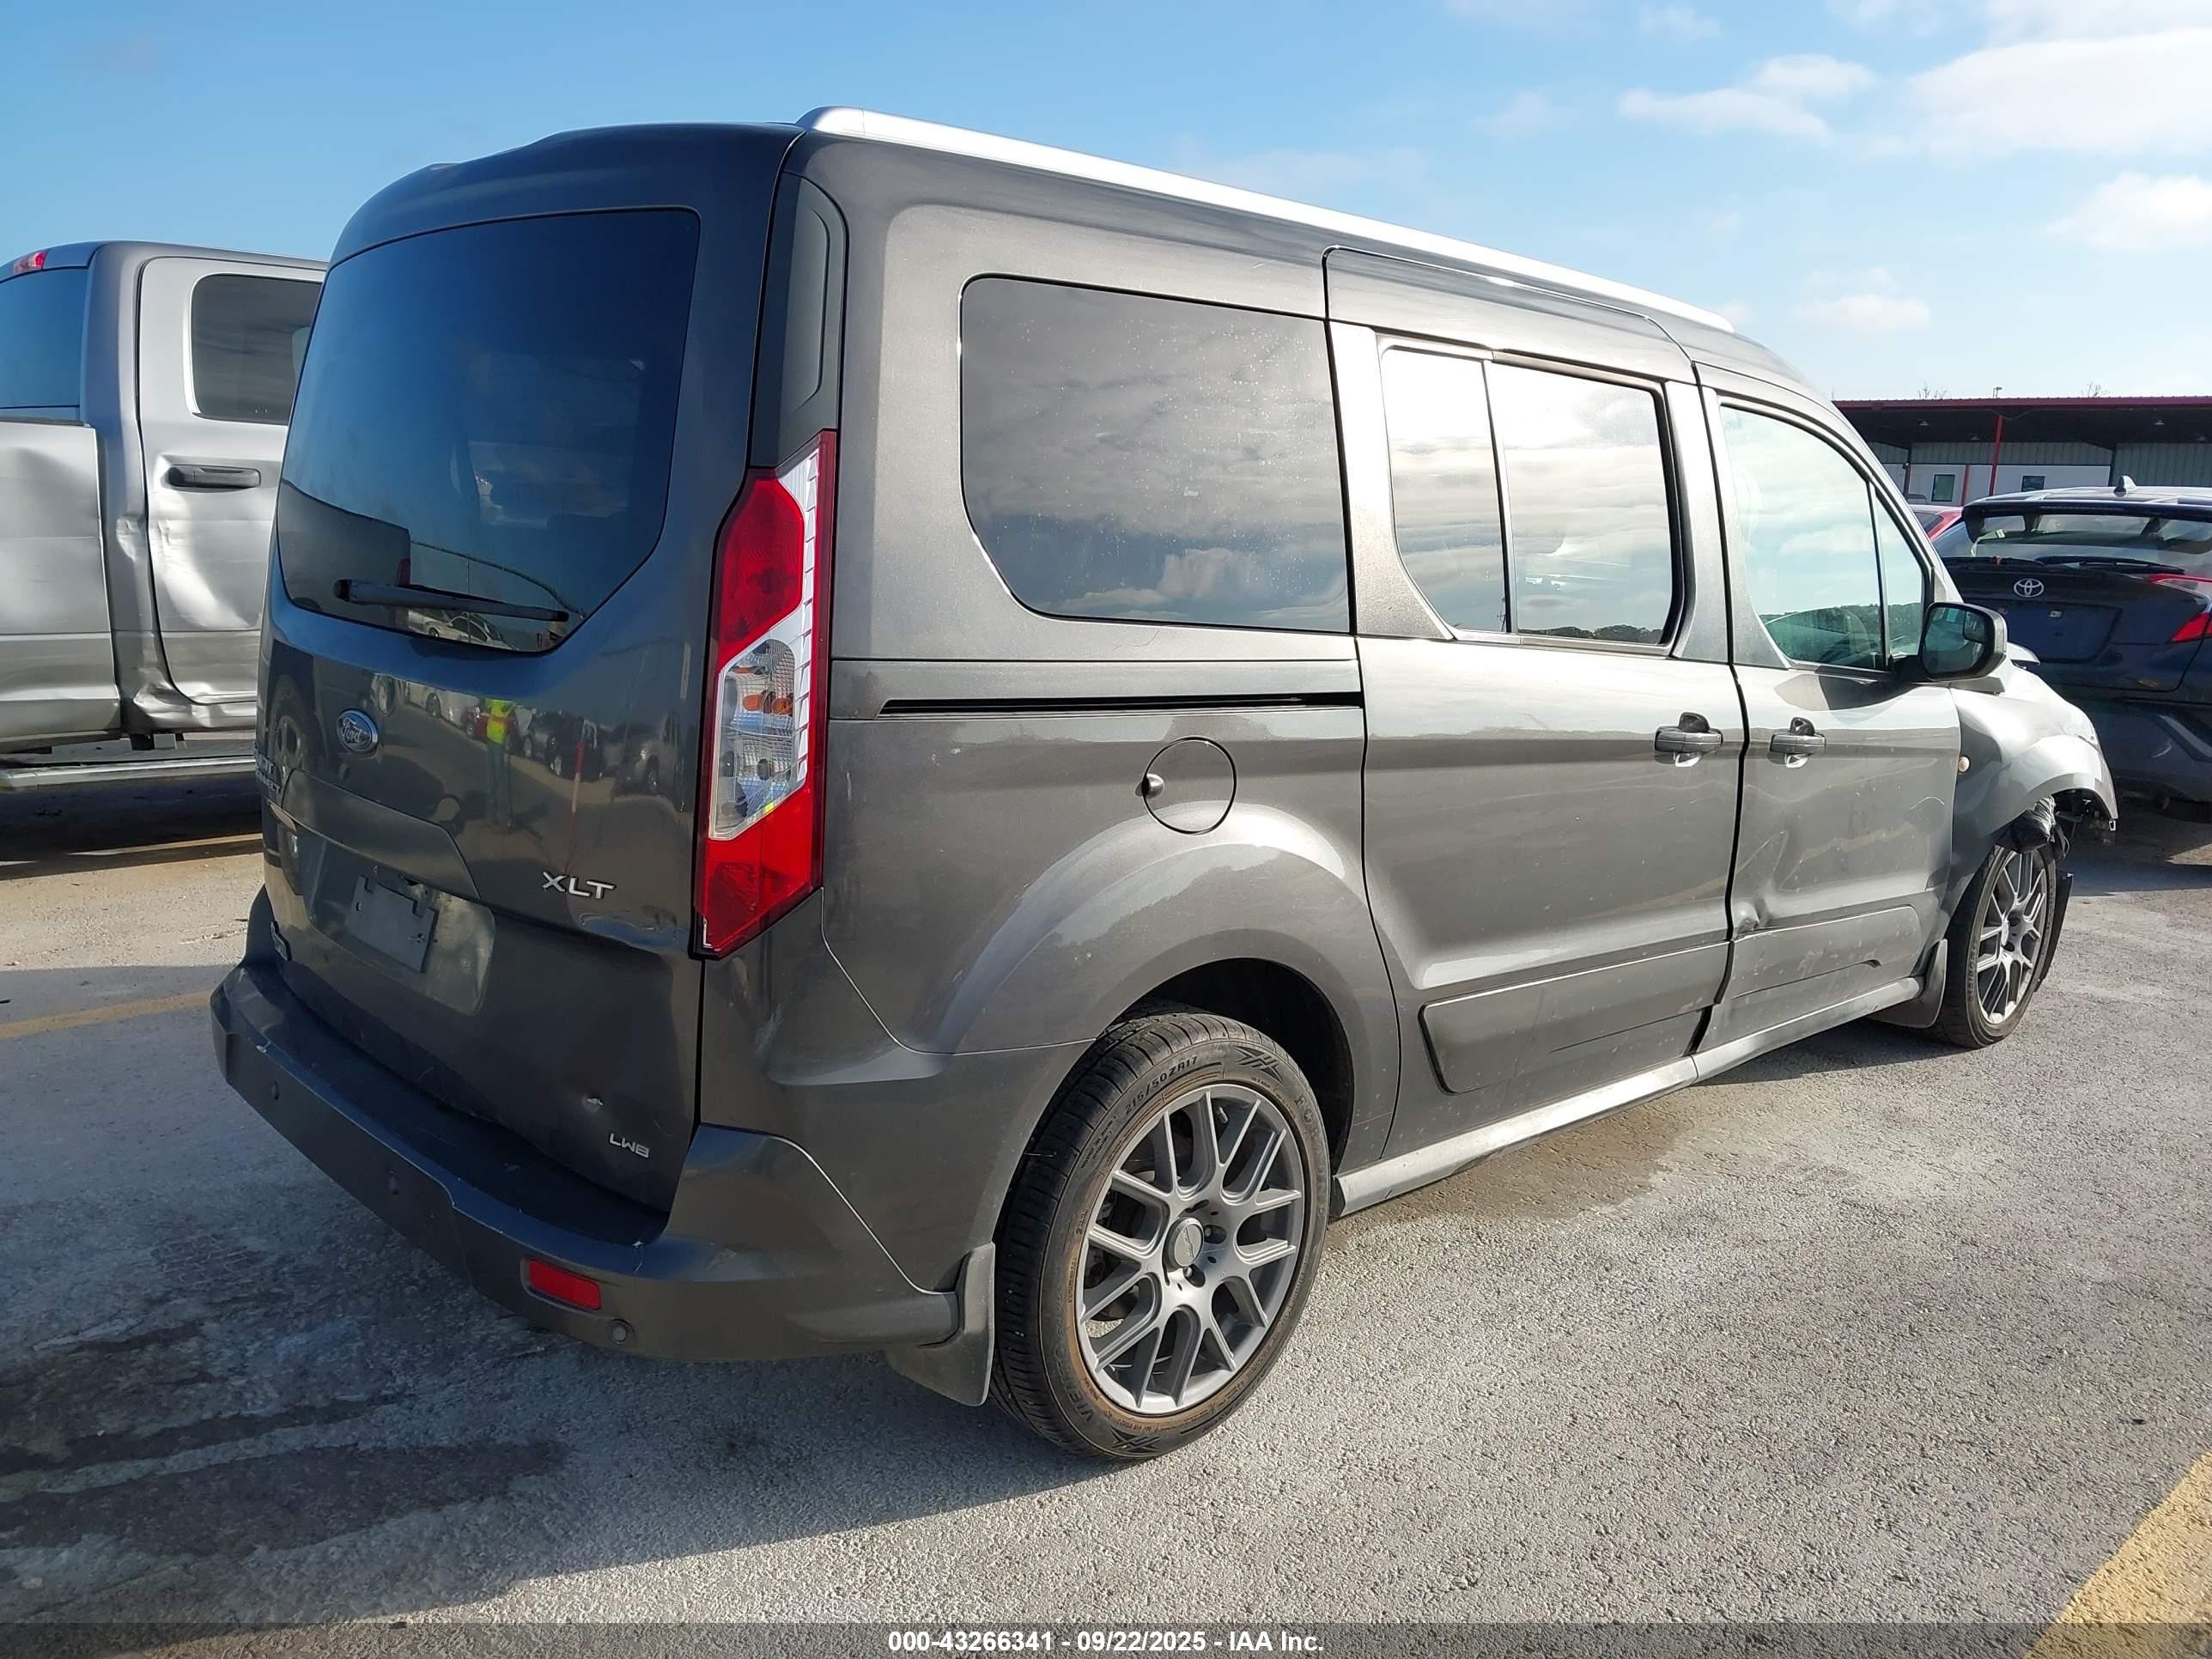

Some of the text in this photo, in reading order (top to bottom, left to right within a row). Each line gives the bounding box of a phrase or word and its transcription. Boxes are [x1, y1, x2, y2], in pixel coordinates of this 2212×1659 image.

[341, 717, 368, 744] Ford
[542, 871, 615, 899] XLT
[1124, 1055, 1199, 1115] 215/50ZR17
[609, 1132, 650, 1158] LWB
